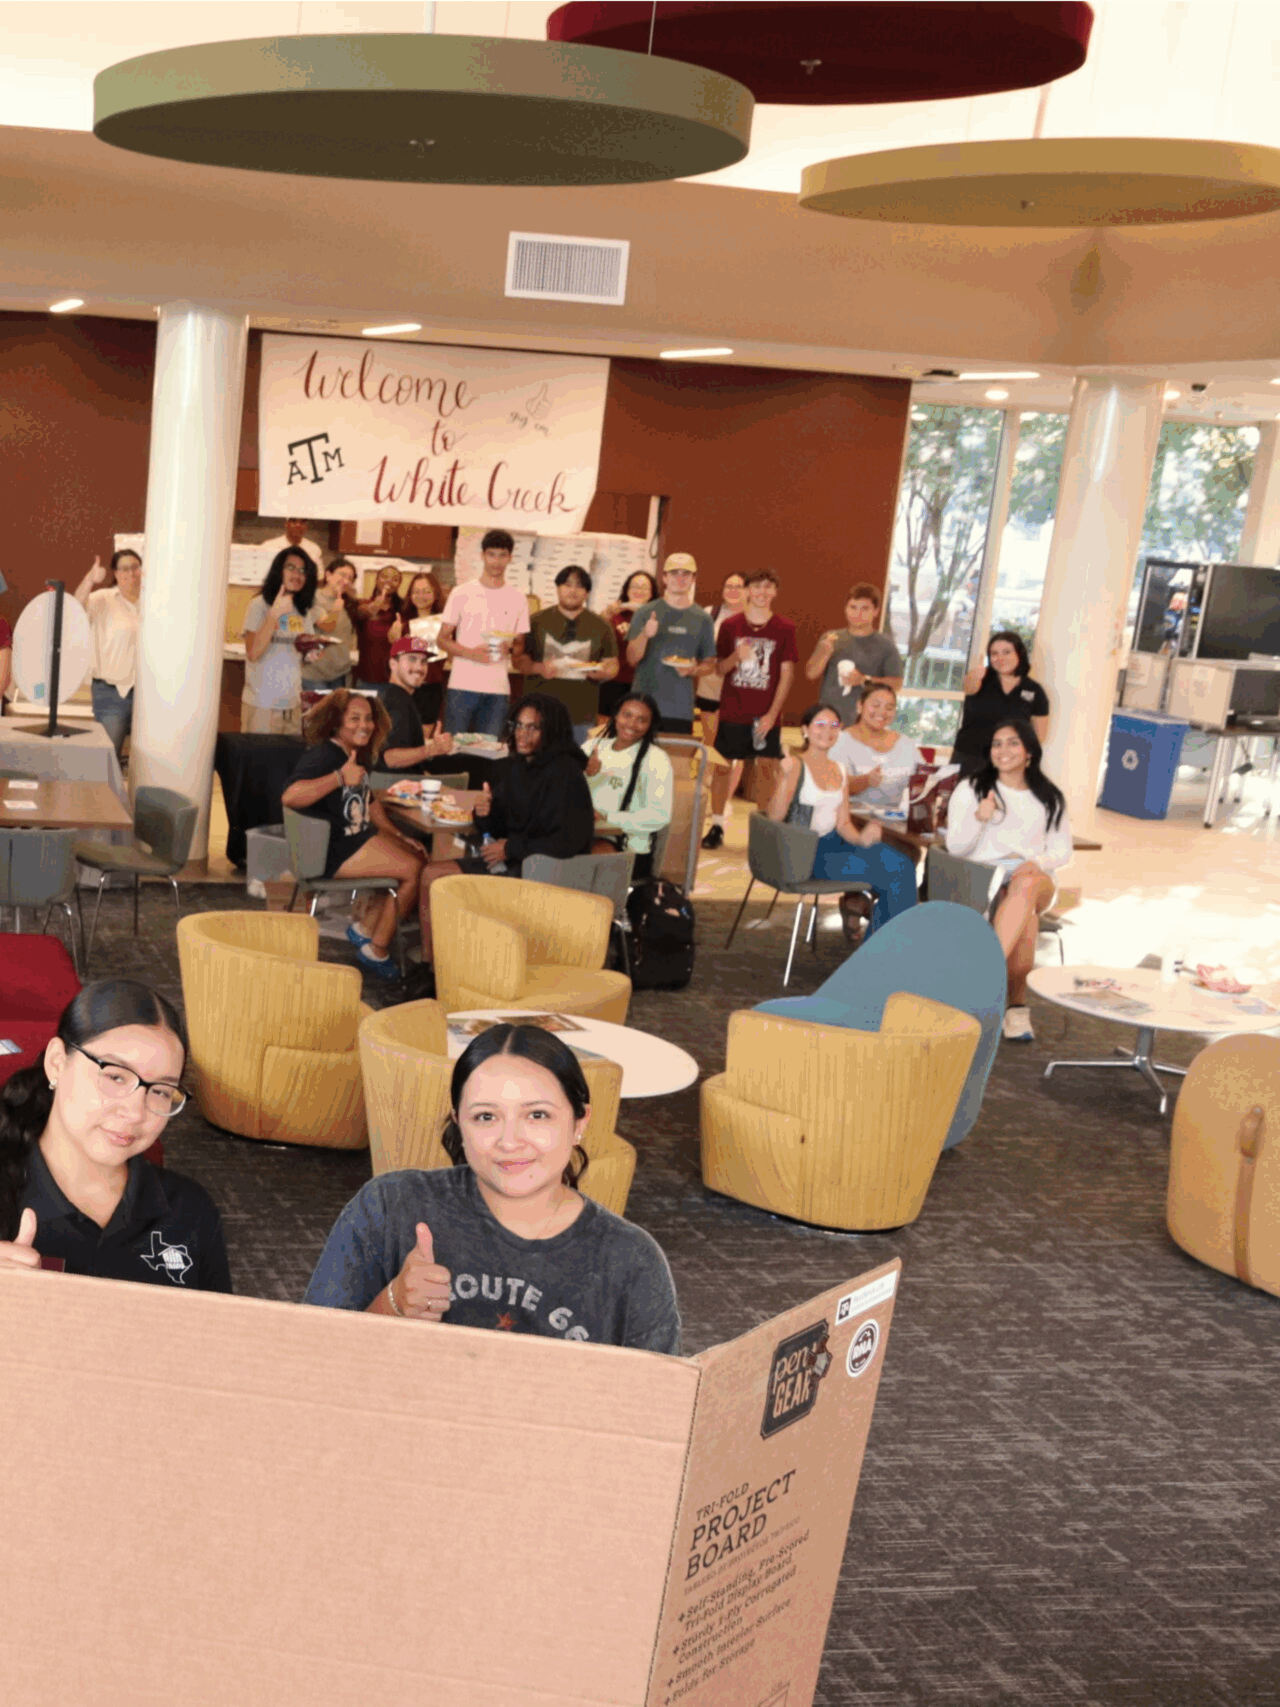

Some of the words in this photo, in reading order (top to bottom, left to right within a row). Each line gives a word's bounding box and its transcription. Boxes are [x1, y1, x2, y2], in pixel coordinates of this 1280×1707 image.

[293, 349, 477, 418] Welcome
[431, 419, 467, 456] to
[369, 455, 473, 508] White
[488, 460, 576, 514] Creek
[450, 1273, 543, 1312] OUTE
[772, 1368, 812, 1419] GEAR
[690, 1468, 796, 1552] PROJECT
[696, 1482, 749, 1522] TRI-FOLD
[685, 1513, 767, 1580] BOARD
[758, 1528, 810, 1570] Pre-Scored
[681, 1621, 716, 1651] Sturdy
[744, 1564, 797, 1608] Corrugated
[684, 1598, 724, 1632] Tri-Fold
[726, 1574, 763, 1605] Display
[765, 1552, 792, 1580] Board
[672, 1678, 699, 1702] Folds
[702, 1666, 718, 1680] for
[720, 1638, 756, 1668] Storage
[676, 1650, 714, 1683] Smooth
[717, 1623, 755, 1654] Interior
[755, 1598, 792, 1628] Surface
[678, 1616, 743, 1664] Construction
